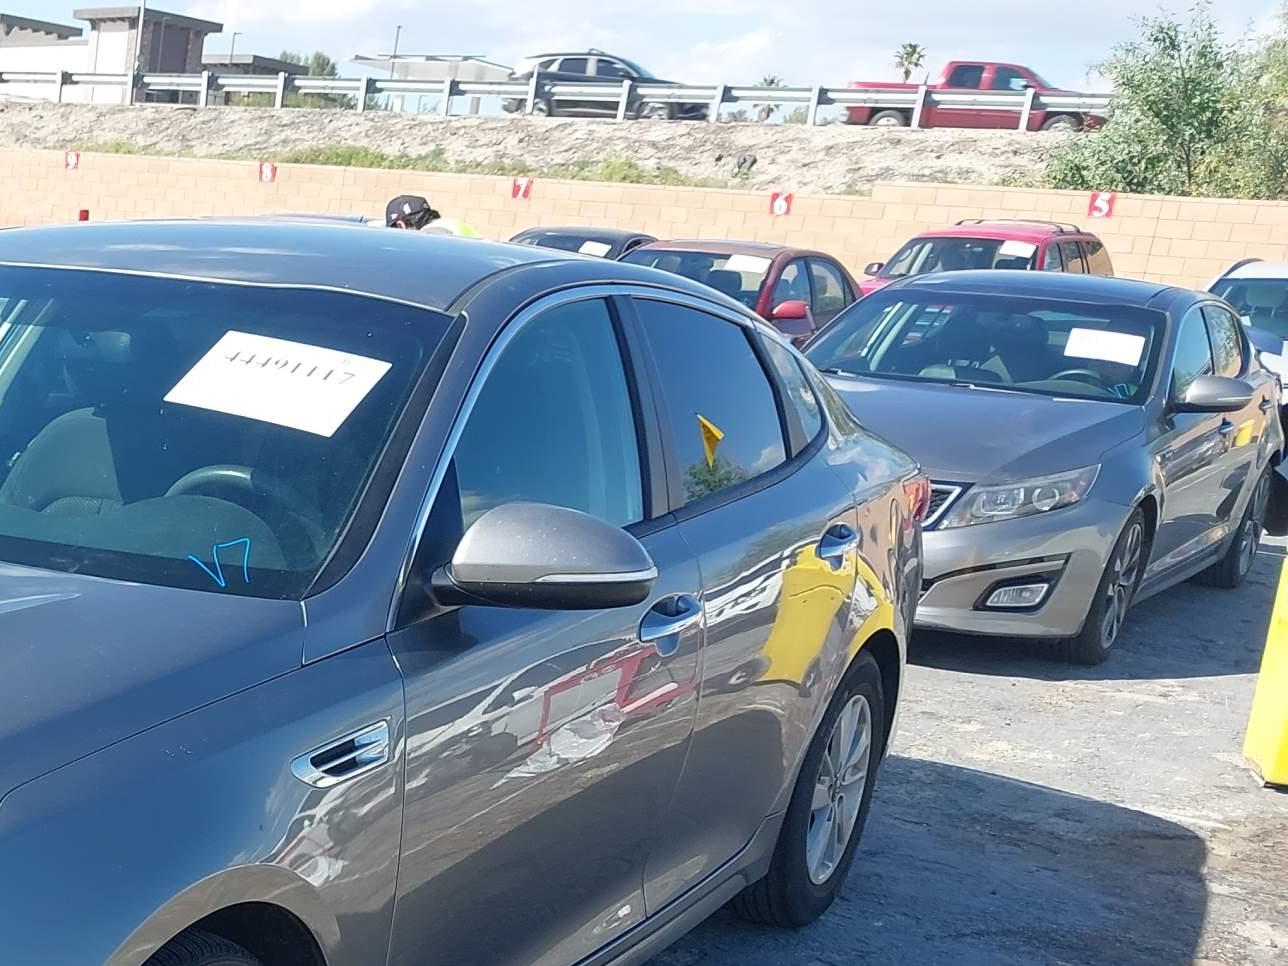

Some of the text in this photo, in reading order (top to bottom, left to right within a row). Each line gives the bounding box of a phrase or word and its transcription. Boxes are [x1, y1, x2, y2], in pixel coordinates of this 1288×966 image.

[262, 162, 272, 182] 8
[515, 177, 530, 198] 7
[773, 193, 787, 215] 6
[1093, 191, 1110, 215] 5
